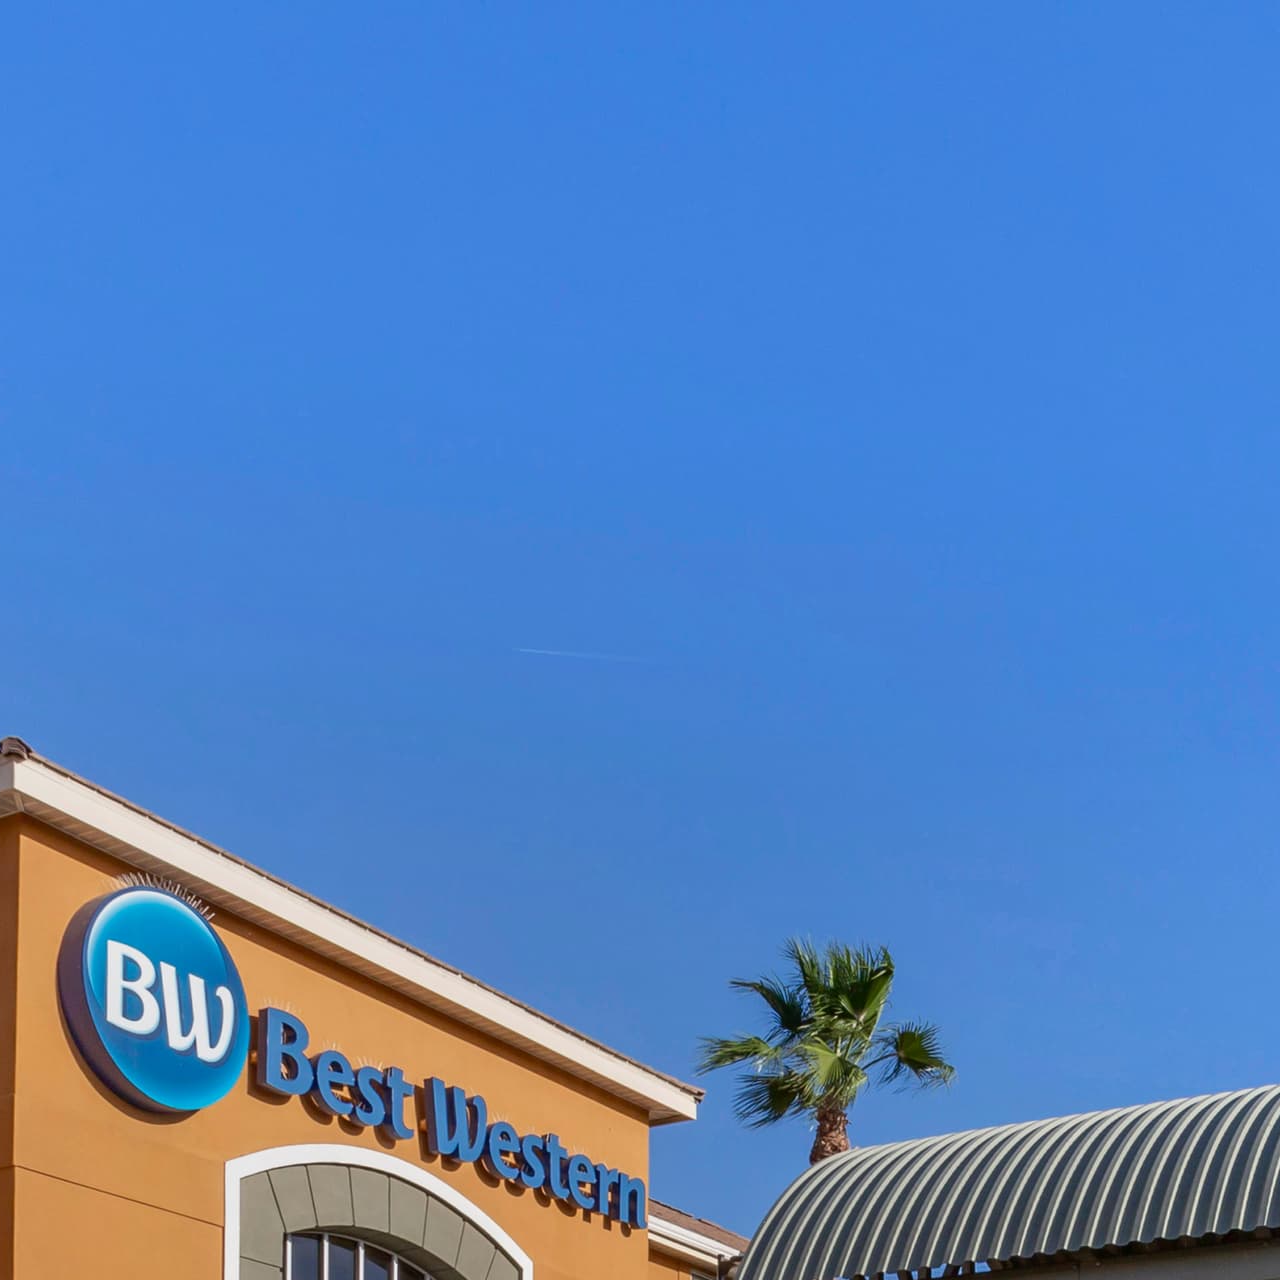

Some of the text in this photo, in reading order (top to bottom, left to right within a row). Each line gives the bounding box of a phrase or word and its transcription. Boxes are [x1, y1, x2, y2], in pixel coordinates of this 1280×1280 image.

[106, 940, 234, 1063] BW
[258, 1006, 646, 1229] Best Western
